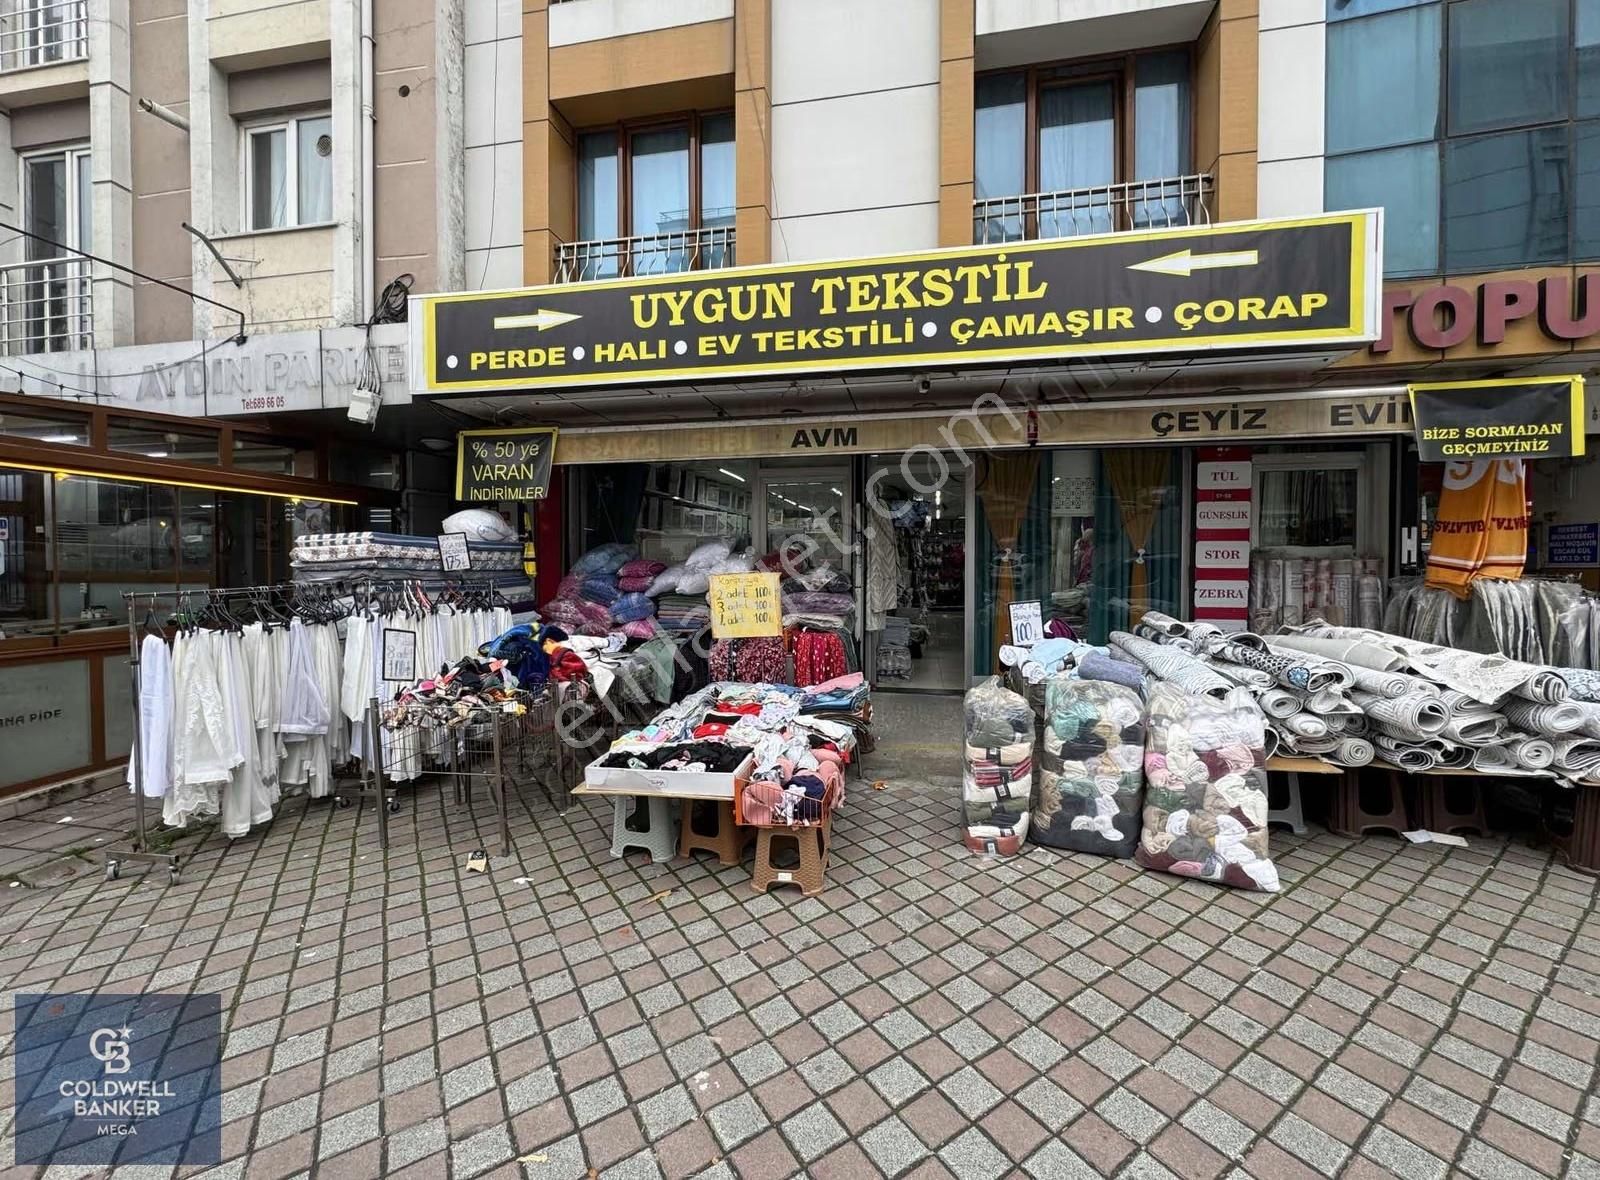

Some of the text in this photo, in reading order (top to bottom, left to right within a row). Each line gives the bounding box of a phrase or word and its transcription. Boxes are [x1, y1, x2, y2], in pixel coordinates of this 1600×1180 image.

[630, 253, 1048, 329] UYGUN TEKSTİL
[1173, 292, 1329, 330] ÇORAP
[950, 307, 1135, 345] ÇAMAŞIR
[698, 317, 914, 356] EV TEKSTİLİ
[470, 347, 566, 371] PERDE
[594, 339, 667, 363] HALI
[1151, 404, 1267, 437] ÇEYİZ
[790, 427, 858, 448] AVM
[1423, 423, 1563, 440] BİZE SORMADAN
[472, 441, 539, 461] % 50 ye
[1442, 438, 1549, 456] GEÇMEYİNİZ
[472, 464, 534, 481] VARAN
[1211, 469, 1239, 481] TÜL
[470, 485, 544, 501] İNDİRİMLER
[1199, 510, 1249, 520] GÜNEŞLİK
[1204, 550, 1240, 559] STOR
[1199, 589, 1244, 599] ZEBRA
